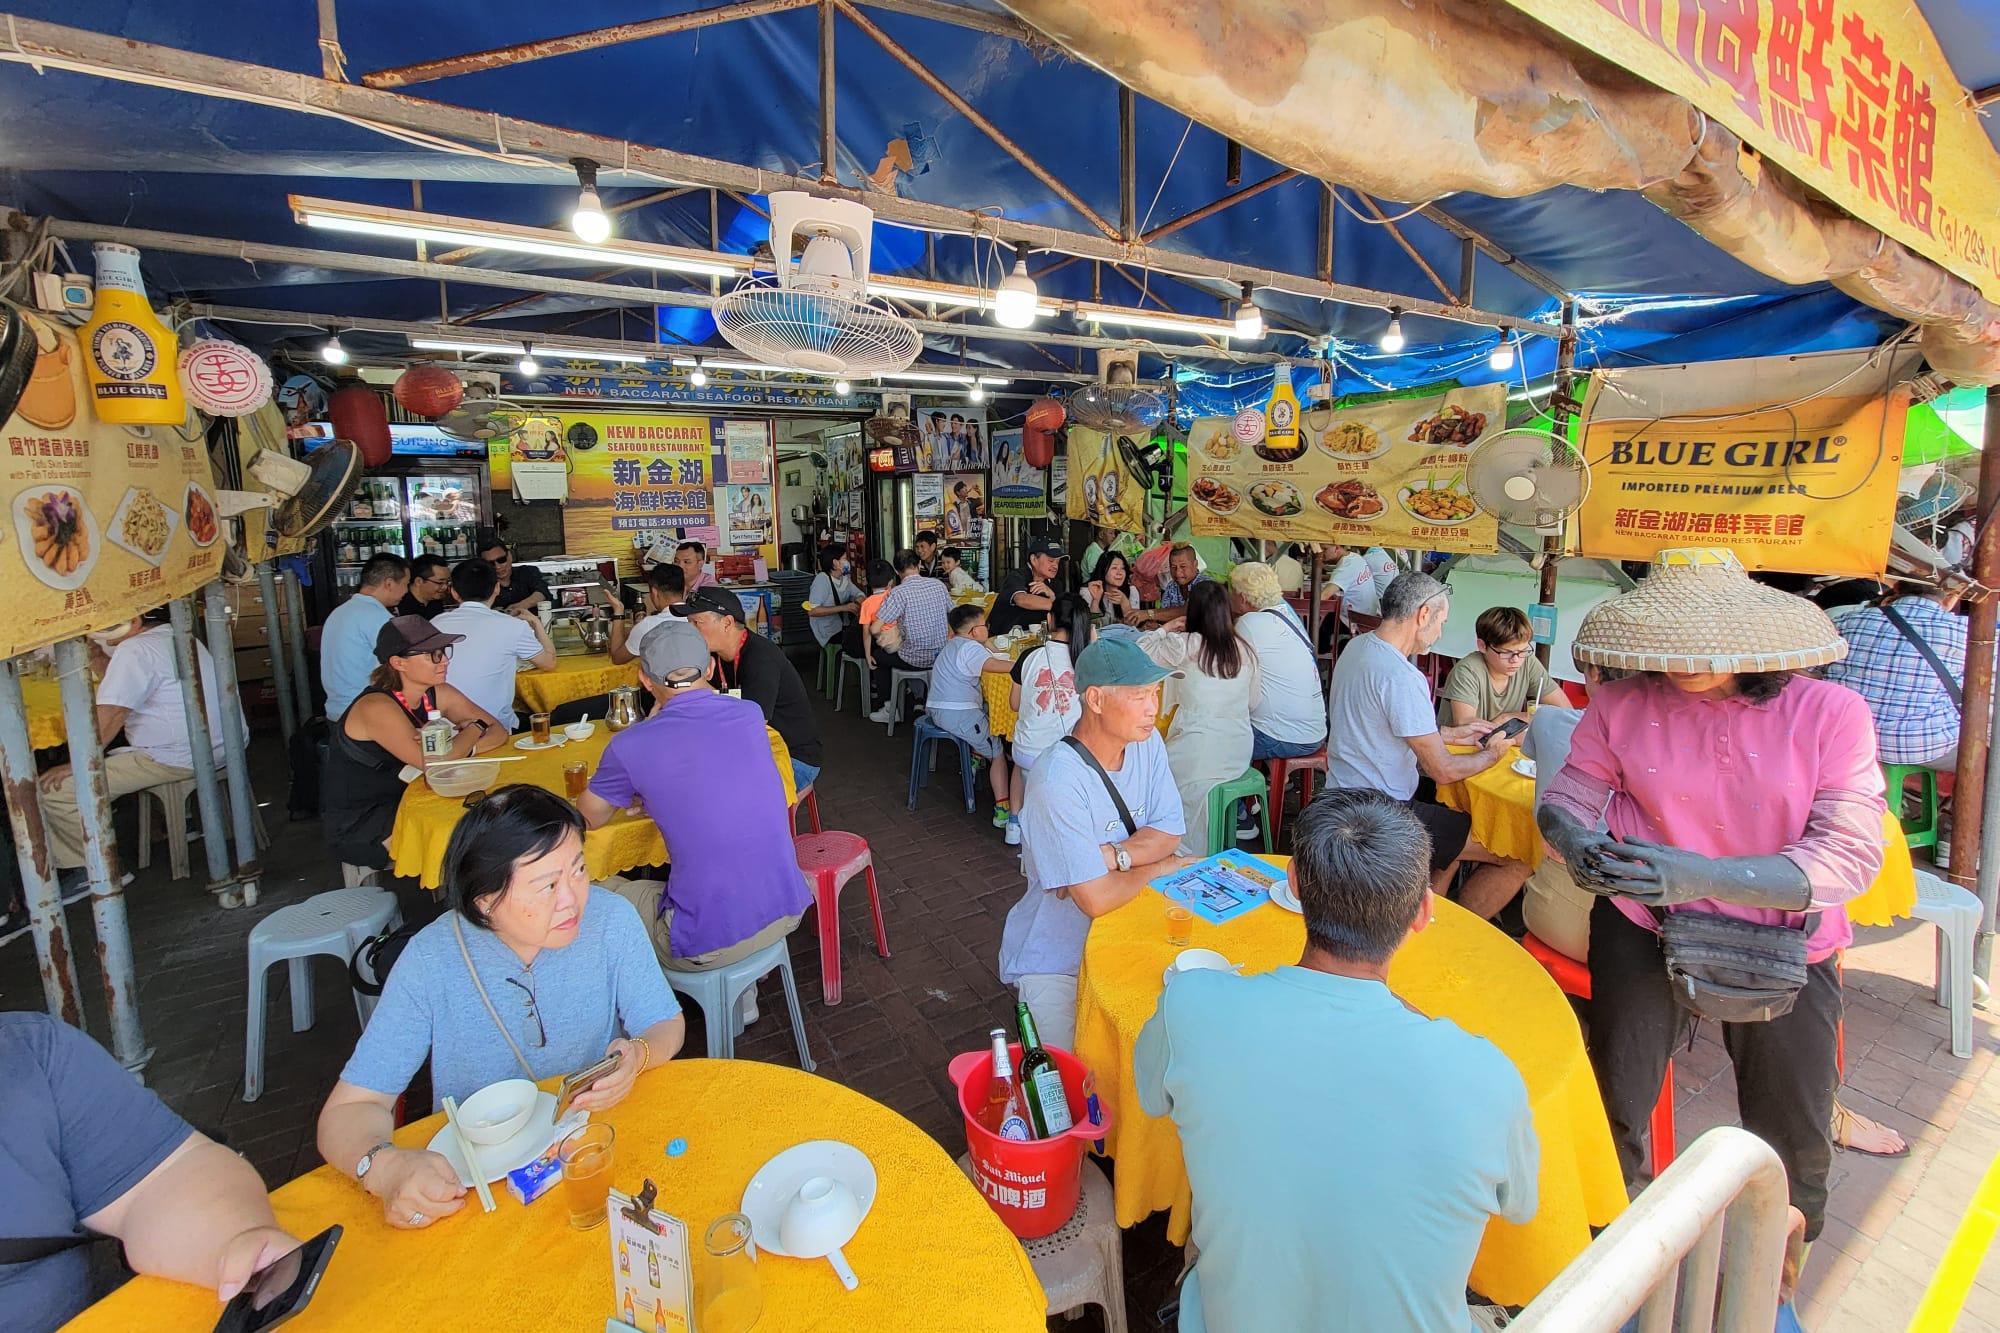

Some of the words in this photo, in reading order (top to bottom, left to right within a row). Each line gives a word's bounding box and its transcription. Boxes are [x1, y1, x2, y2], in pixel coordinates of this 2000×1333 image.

[97, 385, 128, 395] BLUE
[129, 386, 166, 397] GIRL
[565, 387, 601, 396] NEW
[609, 388, 689, 400] BACCARAT
[696, 392, 761, 402] SEAFOOD
[768, 395, 850, 406] RESTAURANT
[606, 425, 636, 439] NEW
[638, 426, 704, 440] BACCARAT
[607, 443, 648, 452] SEAFOOD
[650, 443, 705, 452] RESTAURANT
[1610, 440, 1716, 466] BLUE
[1724, 436, 1840, 467] GIRL
[613, 458, 704, 486] 新金湖
[1621, 481, 1690, 494] IMPORTED
[1694, 484, 1764, 496] PREMIUM
[1767, 484, 1808, 495] BEER
[615, 490, 707, 512] 海鮮菜館
[1615, 507, 1806, 537] 新金湖海鮮菜館
[1634, 531, 1681, 541] BACCARAT
[1681, 535, 1729, 545] SEAFOOD
[1730, 536, 1804, 545] RESTAURANT
[982, 1159, 1003, 1178] San
[1003, 1169, 1047, 1185] Miguel
